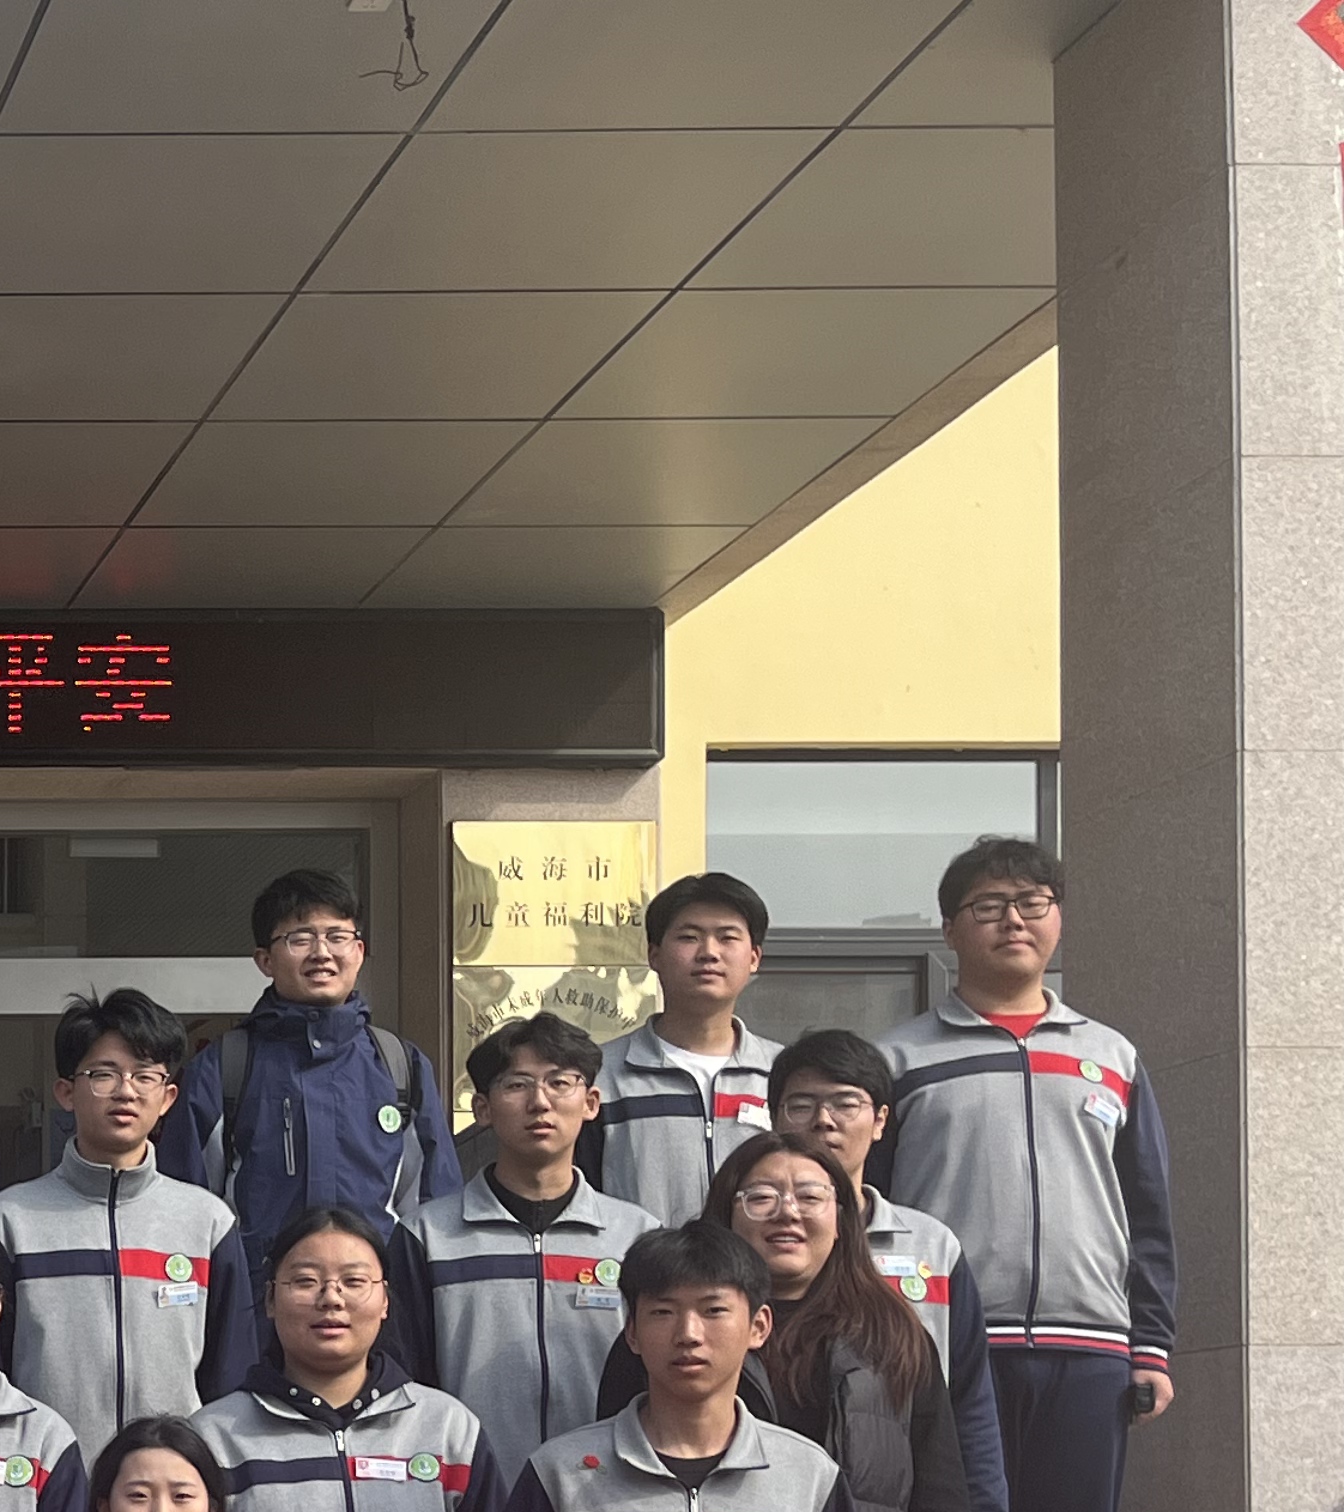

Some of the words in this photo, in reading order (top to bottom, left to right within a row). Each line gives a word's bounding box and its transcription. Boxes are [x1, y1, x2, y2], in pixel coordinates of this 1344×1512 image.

[498, 855, 611, 882] 威海市
[468, 901, 642, 928] 儿童福利院
